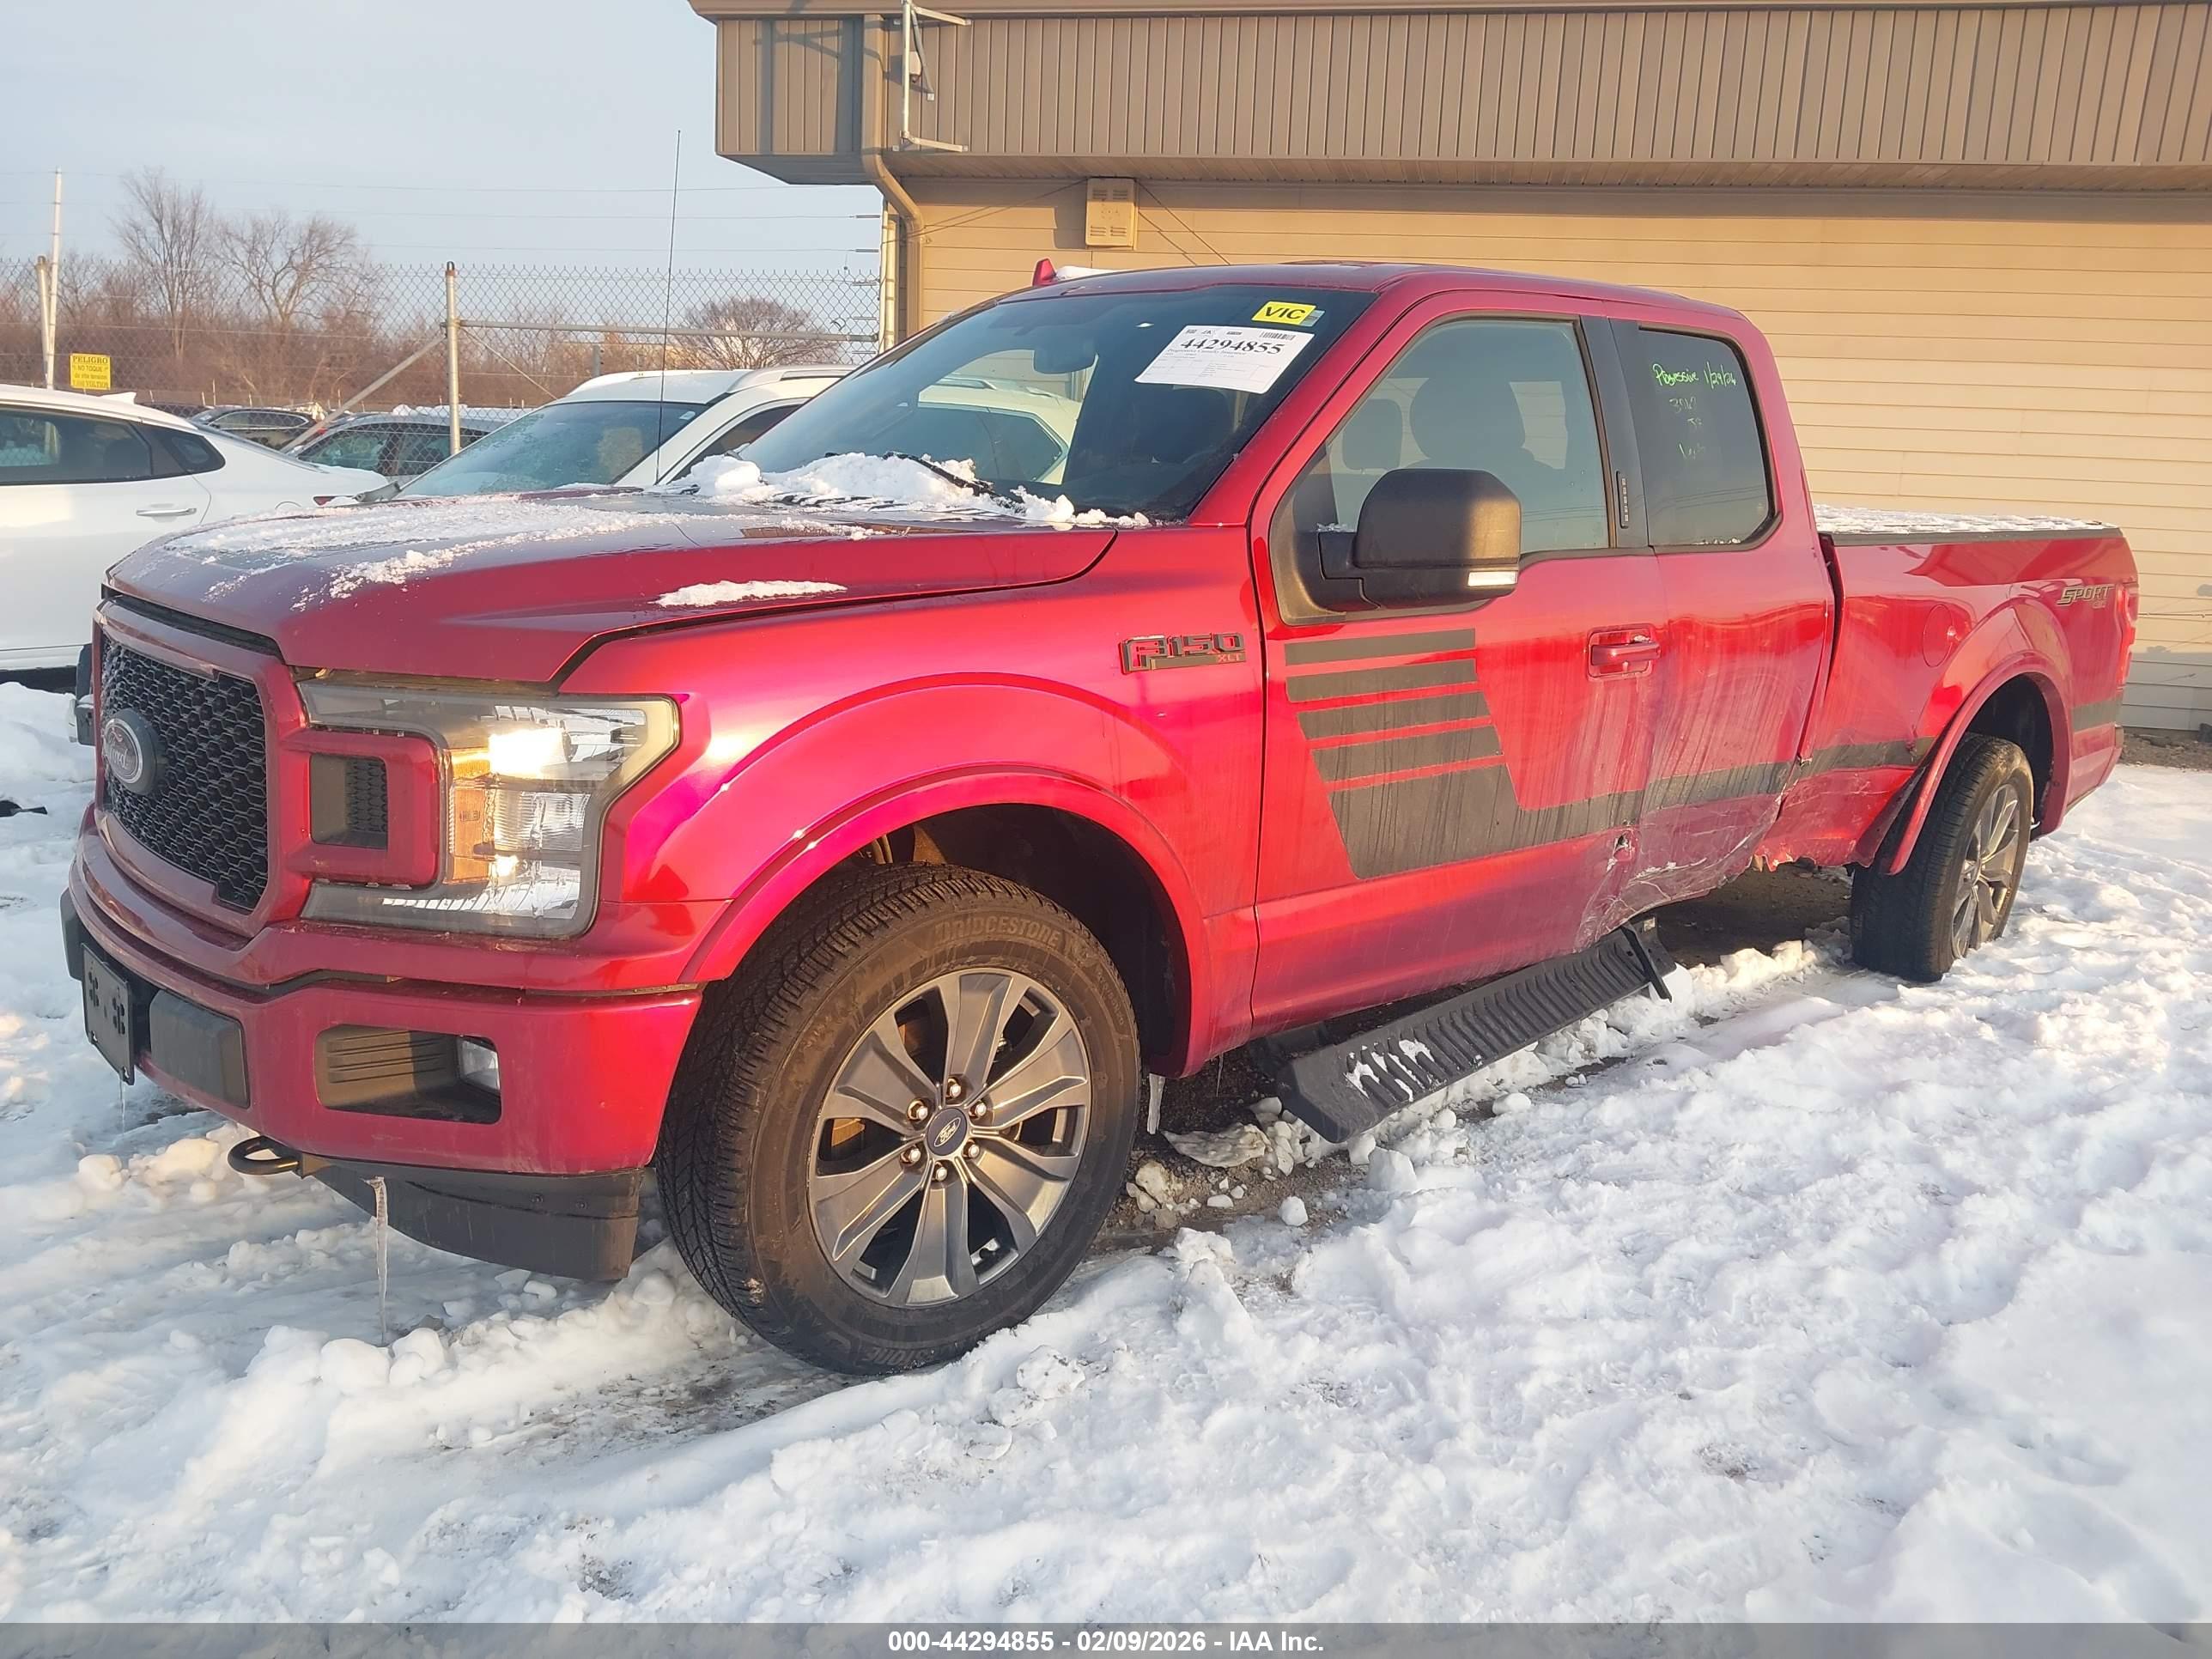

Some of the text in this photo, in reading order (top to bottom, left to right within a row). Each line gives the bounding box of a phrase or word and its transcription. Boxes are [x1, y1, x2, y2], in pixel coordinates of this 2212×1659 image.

[1265, 306, 1306, 320] VIC
[1180, 337, 1285, 355] 44294855
[72, 356, 108, 364] PELIGRO
[2057, 585, 2115, 606] SPORT
[1218, 653, 1242, 663] XLT
[939, 1121, 957, 1143] Ford
